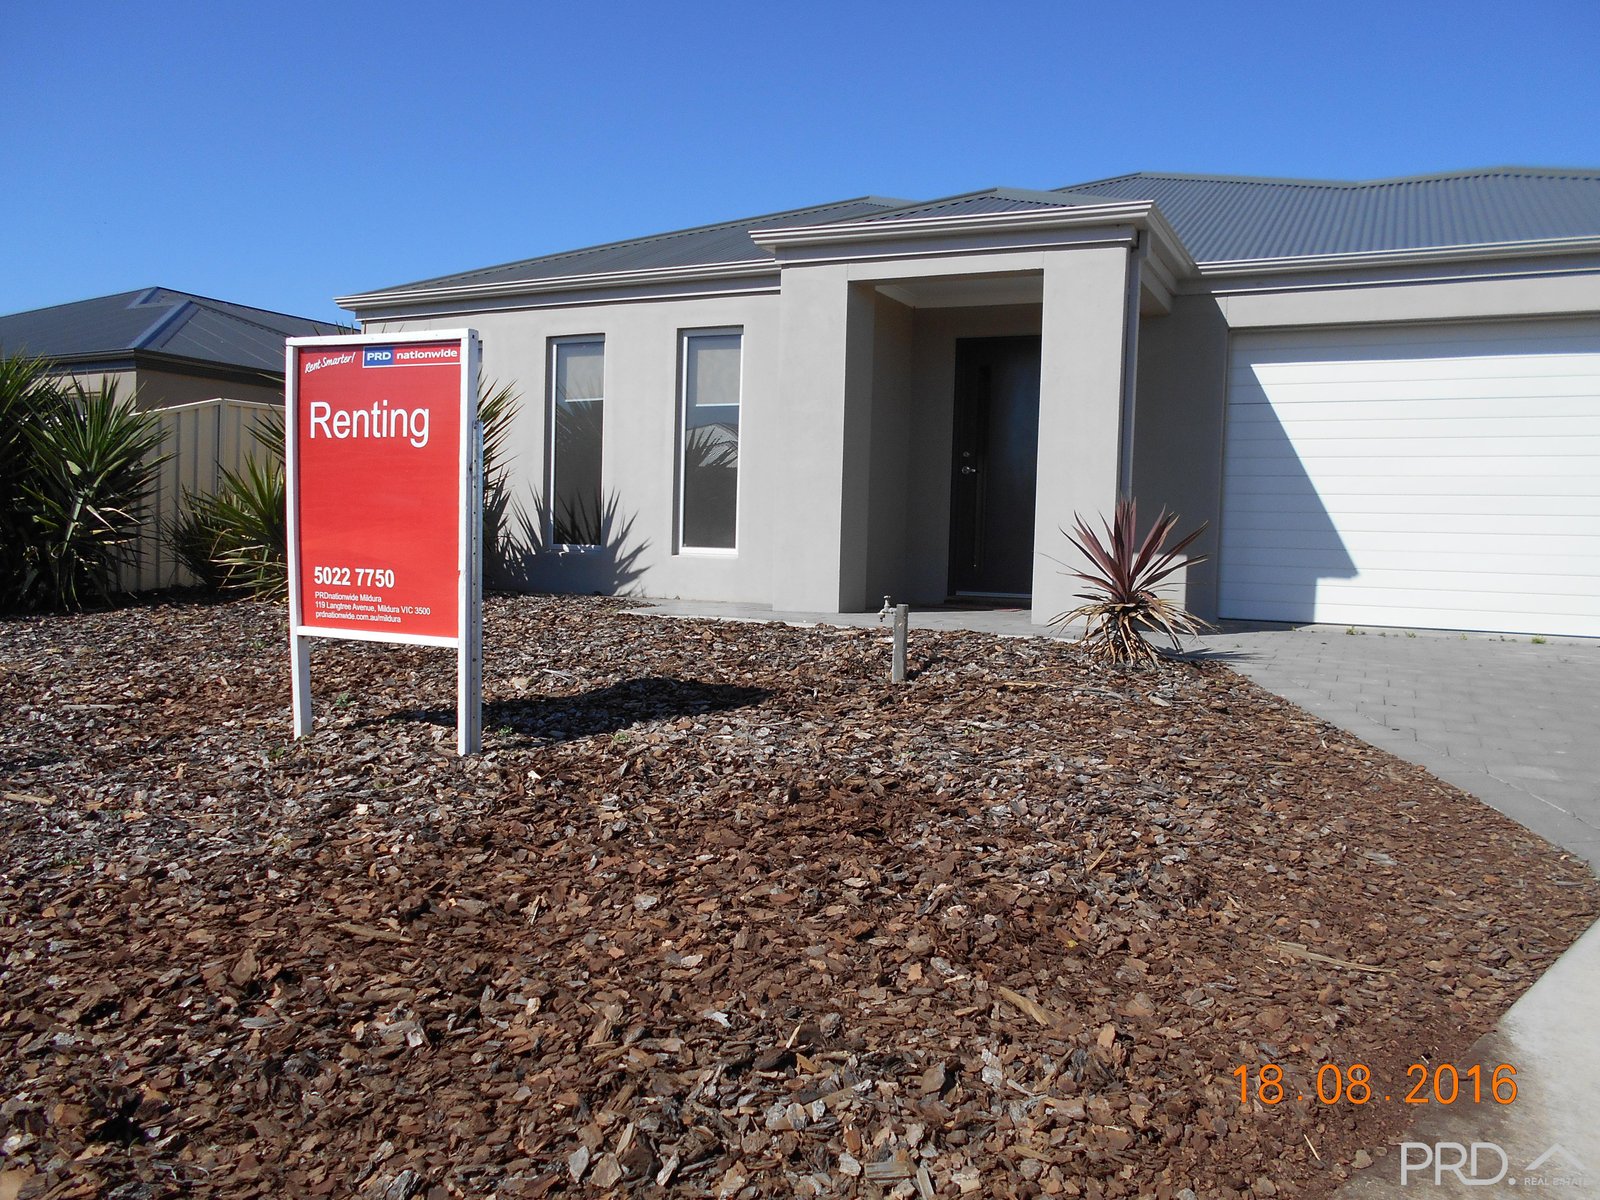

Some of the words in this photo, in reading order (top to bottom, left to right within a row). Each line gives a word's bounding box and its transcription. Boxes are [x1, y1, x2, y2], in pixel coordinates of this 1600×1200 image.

[304, 361, 321, 373] Rent
[321, 352, 356, 366] Smarter!
[366, 352, 392, 361] PRD
[396, 349, 458, 359] nationwide
[310, 399, 429, 448] Renting
[314, 566, 351, 586] 5022
[355, 568, 395, 588] 7750
[315, 591, 358, 601] PRDnationwide
[360, 593, 382, 602] Mildura
[315, 601, 326, 609] 119
[326, 602, 351, 612] Langtree
[352, 604, 376, 613] Avenue,
[377, 605, 399, 613] Mildura
[401, 606, 414, 615] VIC
[415, 607, 431, 616] 3500
[315, 611, 401, 623] prdnationwide.com.au/mildura
